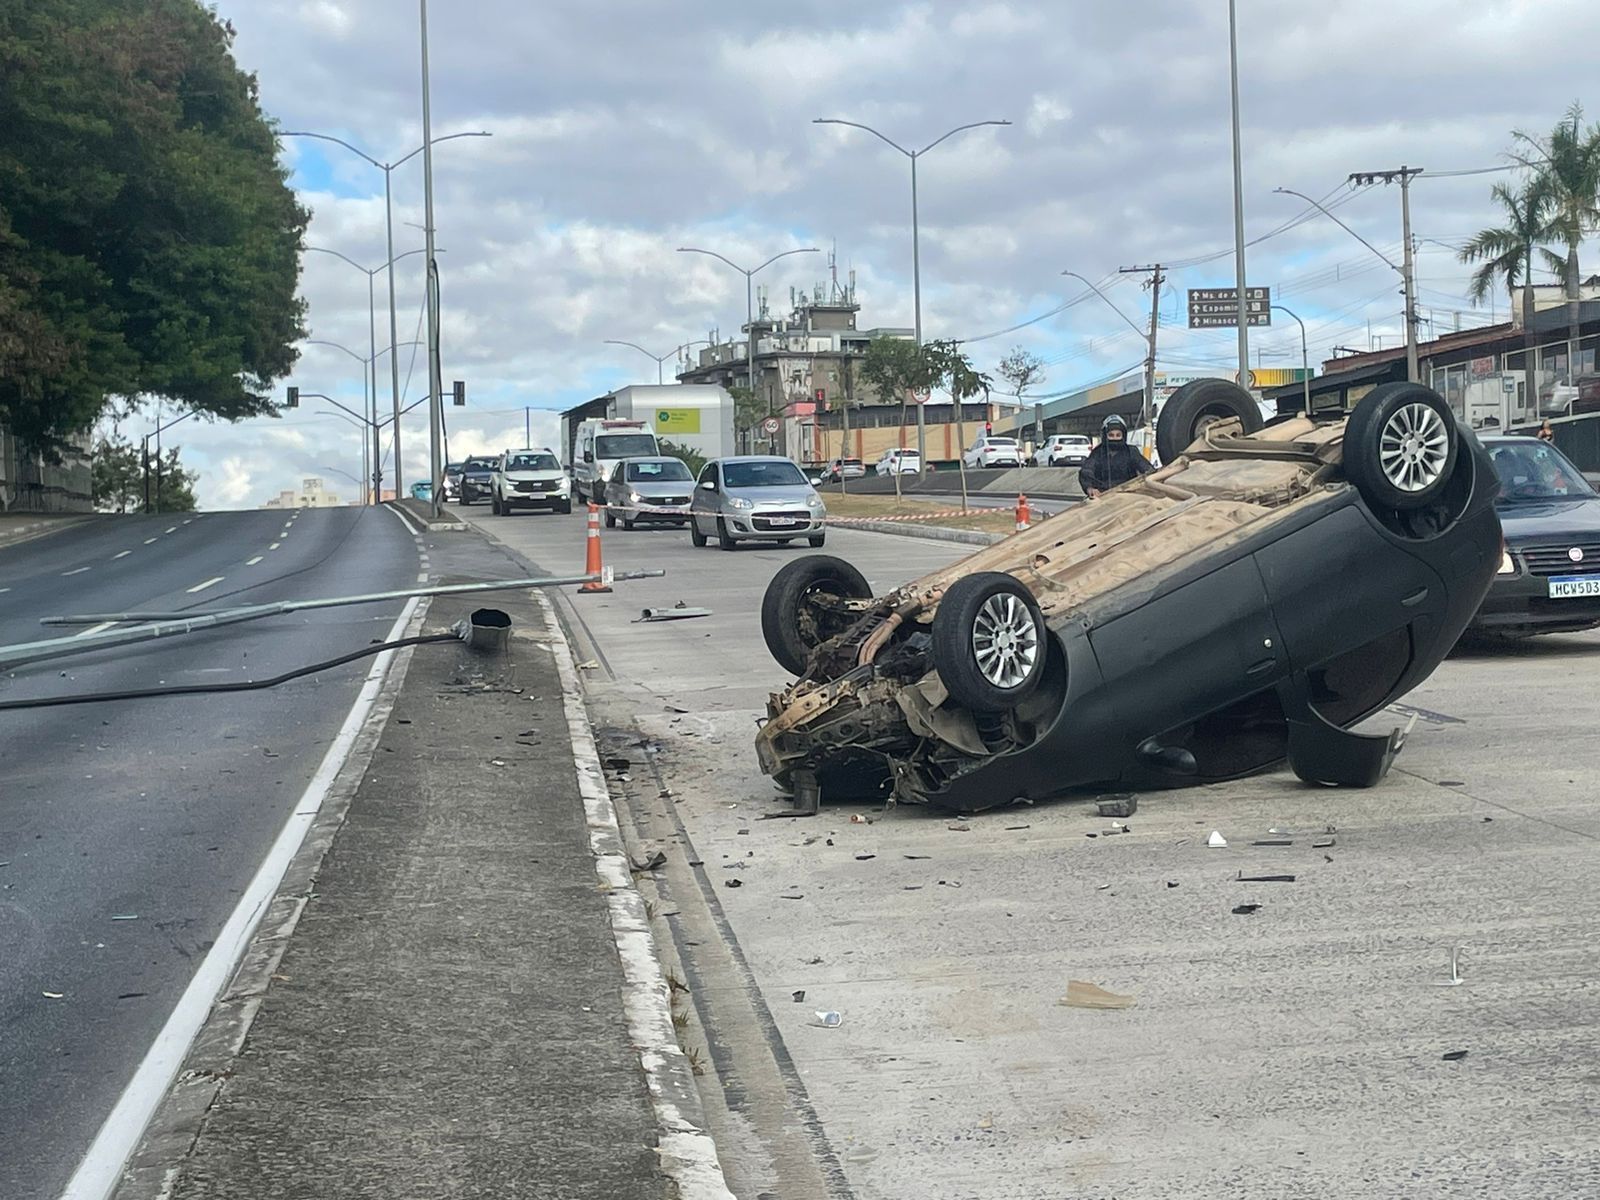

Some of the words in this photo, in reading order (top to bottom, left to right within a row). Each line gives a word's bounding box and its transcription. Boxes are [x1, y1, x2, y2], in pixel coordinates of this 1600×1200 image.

[1218, 291, 1228, 299] de
[1231, 291, 1251, 299] Ae
[1202, 317, 1256, 325] Minascero
[766, 421, 777, 429] 60
